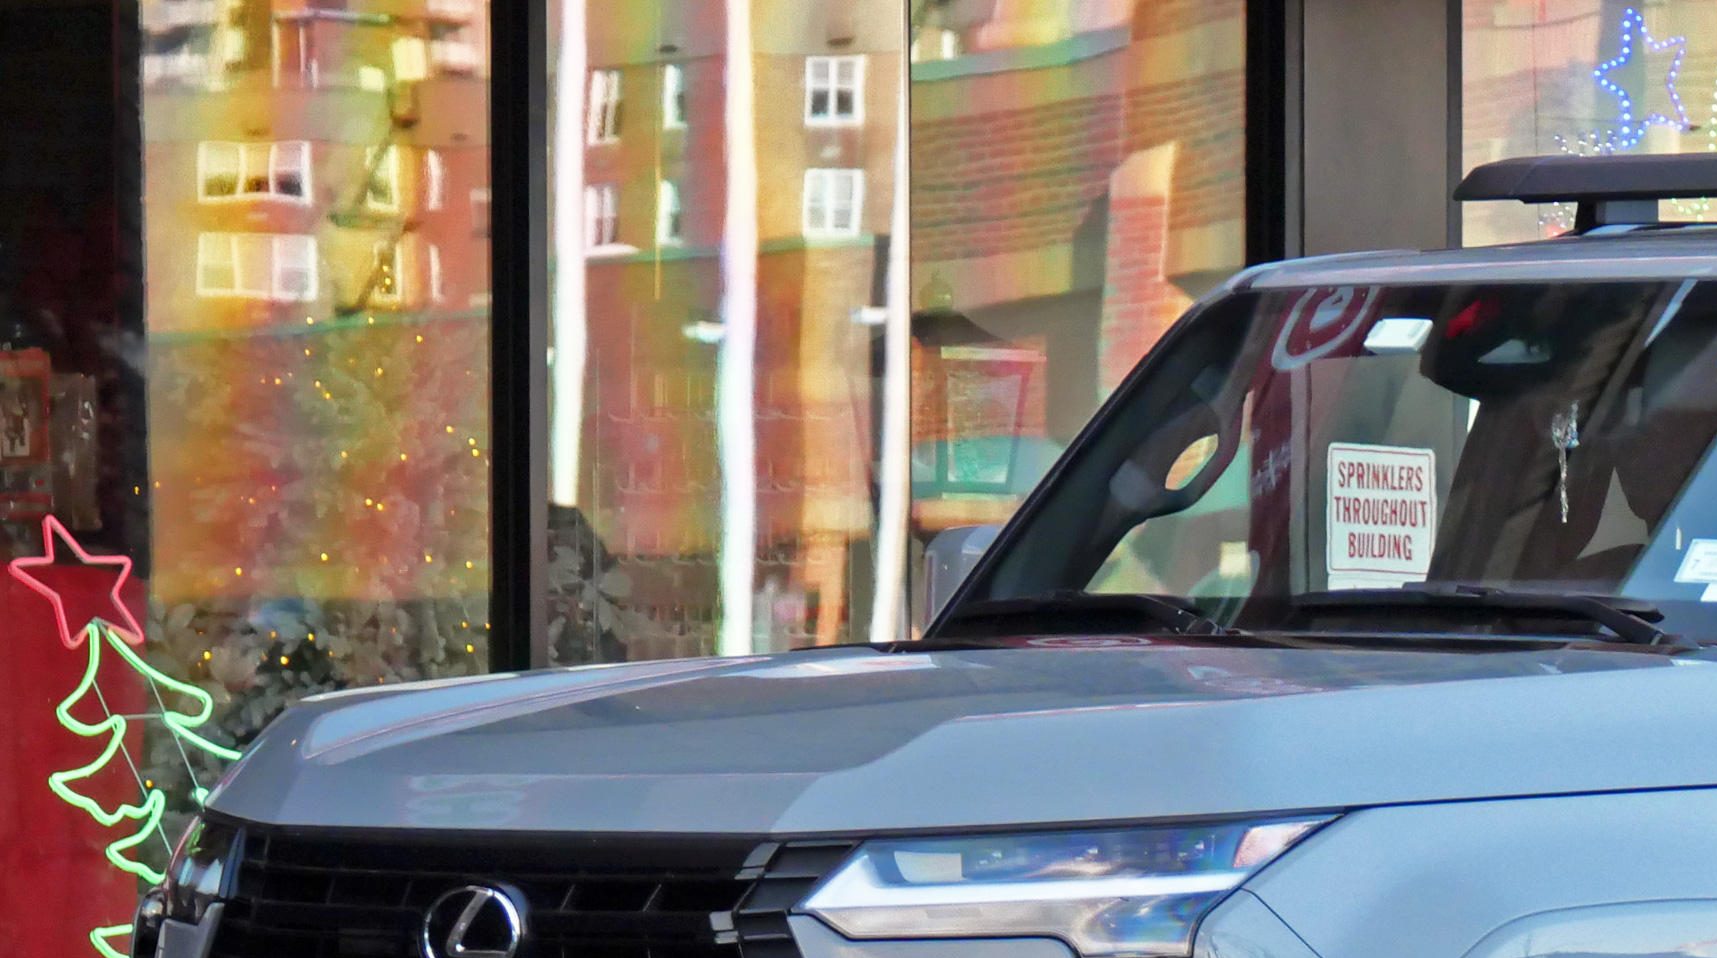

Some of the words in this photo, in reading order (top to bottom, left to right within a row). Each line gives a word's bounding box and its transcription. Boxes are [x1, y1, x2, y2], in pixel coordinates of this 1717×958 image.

[1337, 461, 1424, 492] SPRINKLERS
[1334, 496, 1428, 528] THROUGHOUT
[1348, 532, 1413, 561] BUILDING
